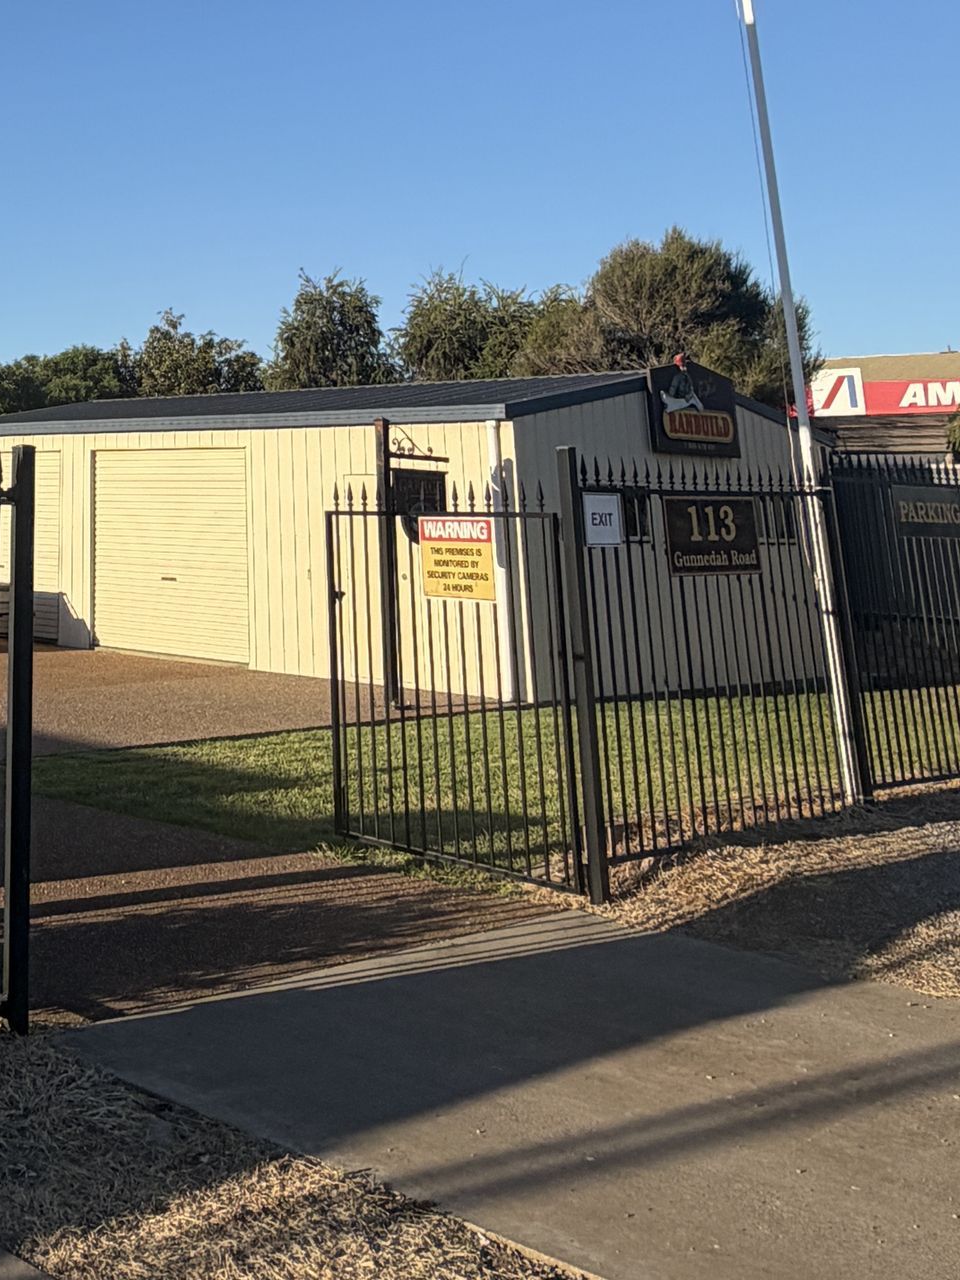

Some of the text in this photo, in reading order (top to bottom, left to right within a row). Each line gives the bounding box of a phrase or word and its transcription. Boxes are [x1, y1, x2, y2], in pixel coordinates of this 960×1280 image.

[591, 512, 613, 527] EXIT
[899, 501, 960, 524] PARKING
[423, 521, 488, 539] WARNING
[687, 505, 736, 541] 113
[430, 547, 482, 557] THIS PREMISES IS
[674, 549, 758, 567] Gunnedah Road
[434, 559, 479, 569] MONITORED BY
[427, 571, 489, 581] SECURITY CAMERAS
[443, 583, 473, 593] 24 HOURS
